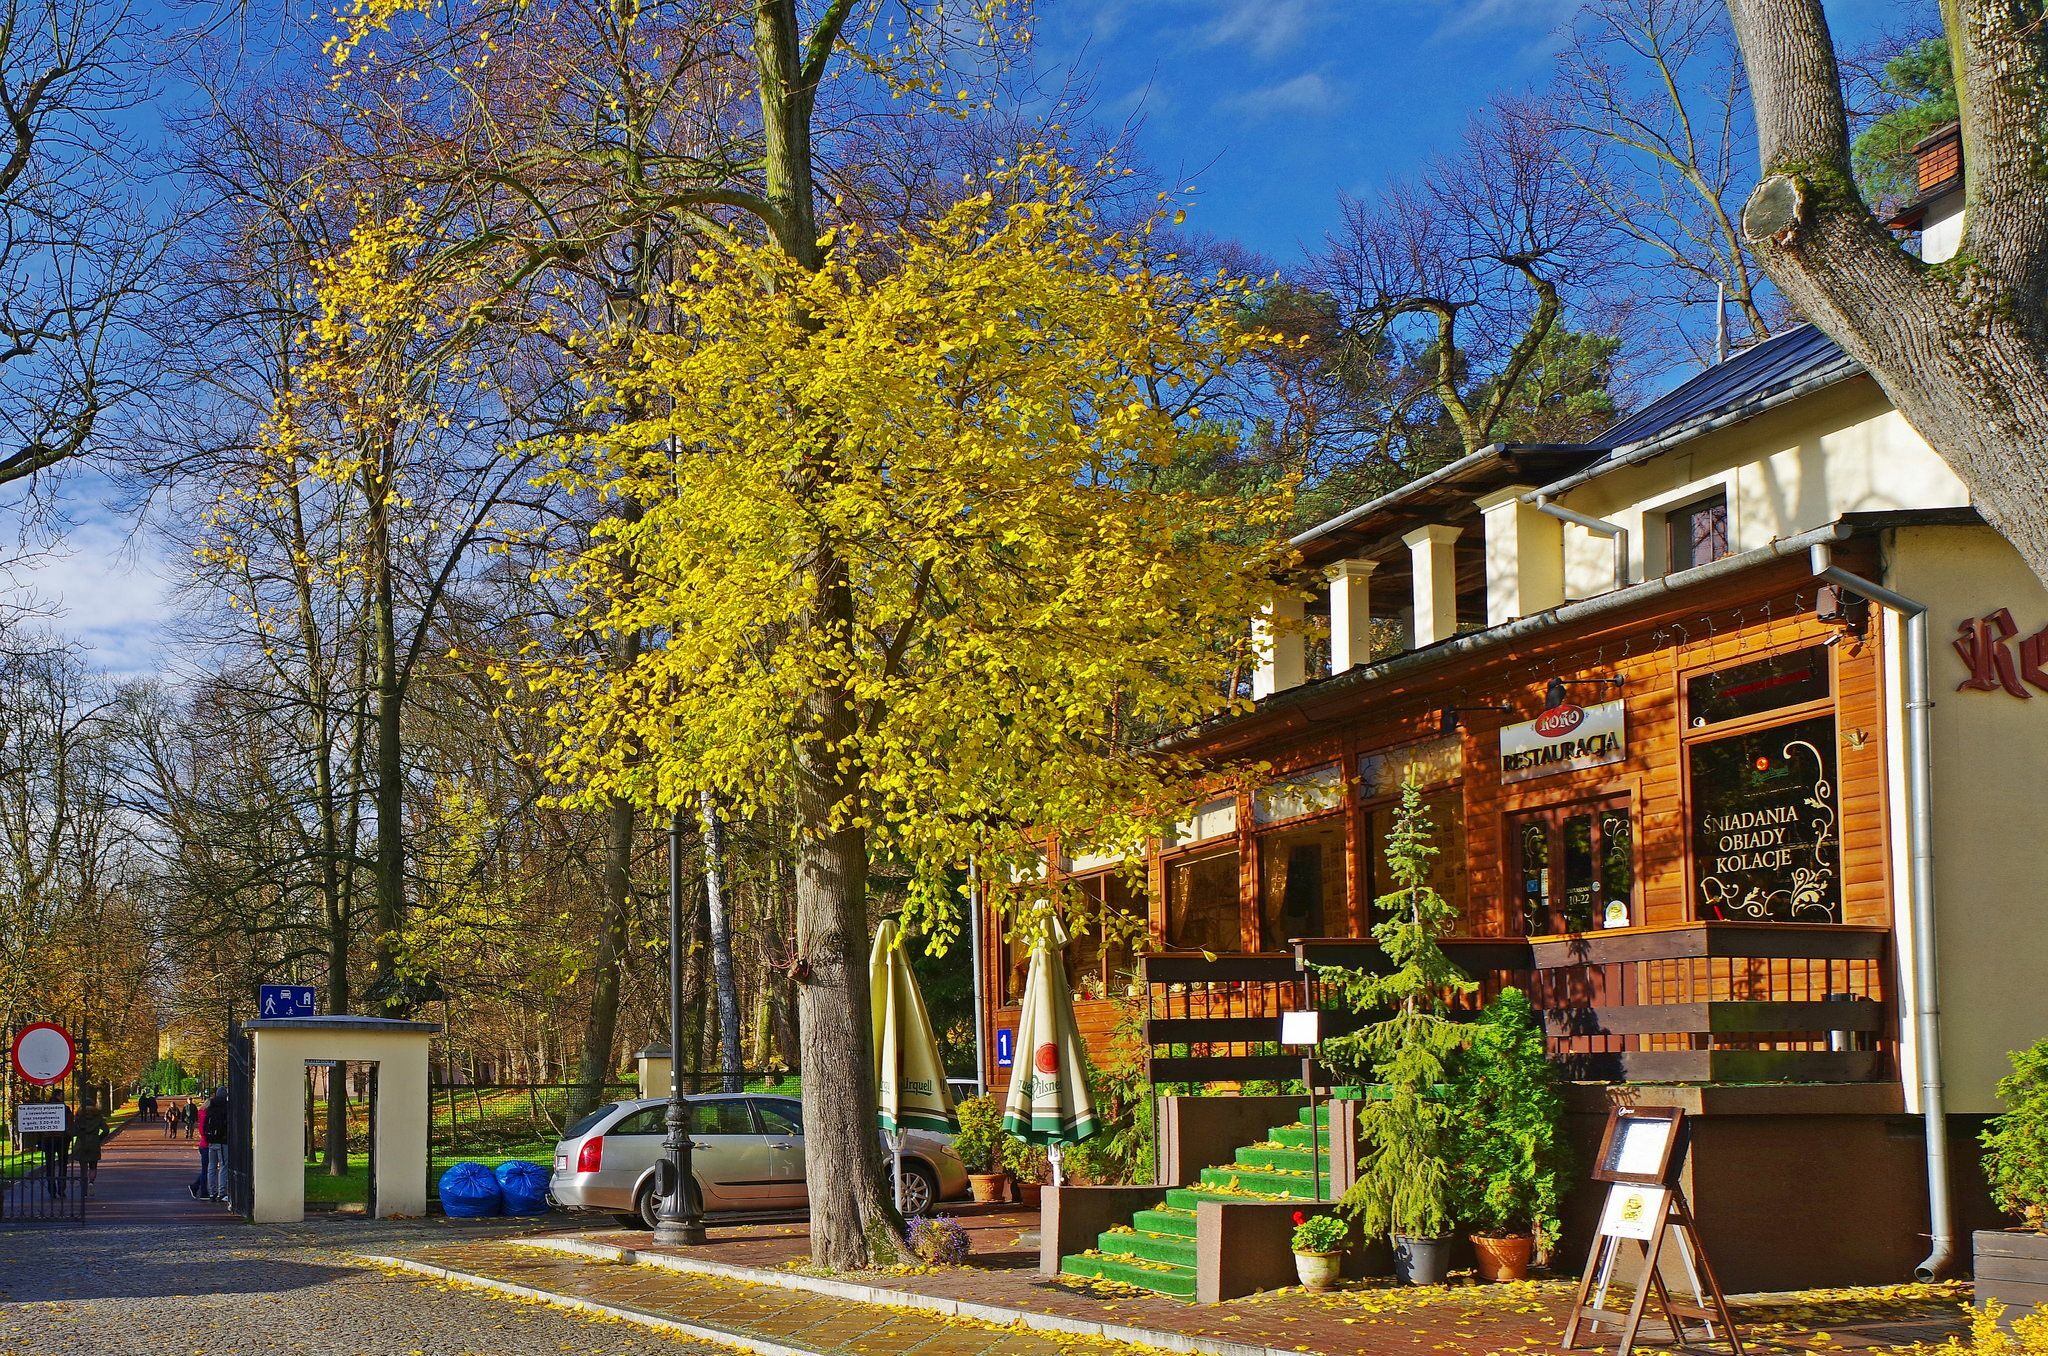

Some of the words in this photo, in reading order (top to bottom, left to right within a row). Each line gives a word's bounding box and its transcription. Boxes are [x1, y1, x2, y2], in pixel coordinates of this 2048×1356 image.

[1502, 732, 1620, 772] RESTAURACJA
[1703, 805, 1799, 835] ŚNIADANIA
[1719, 827, 1786, 852] OBIADY
[1716, 848, 1792, 874] KOLACJE
[1568, 893, 1590, 905] 10-22
[1000, 1034, 1007, 1056] 1
